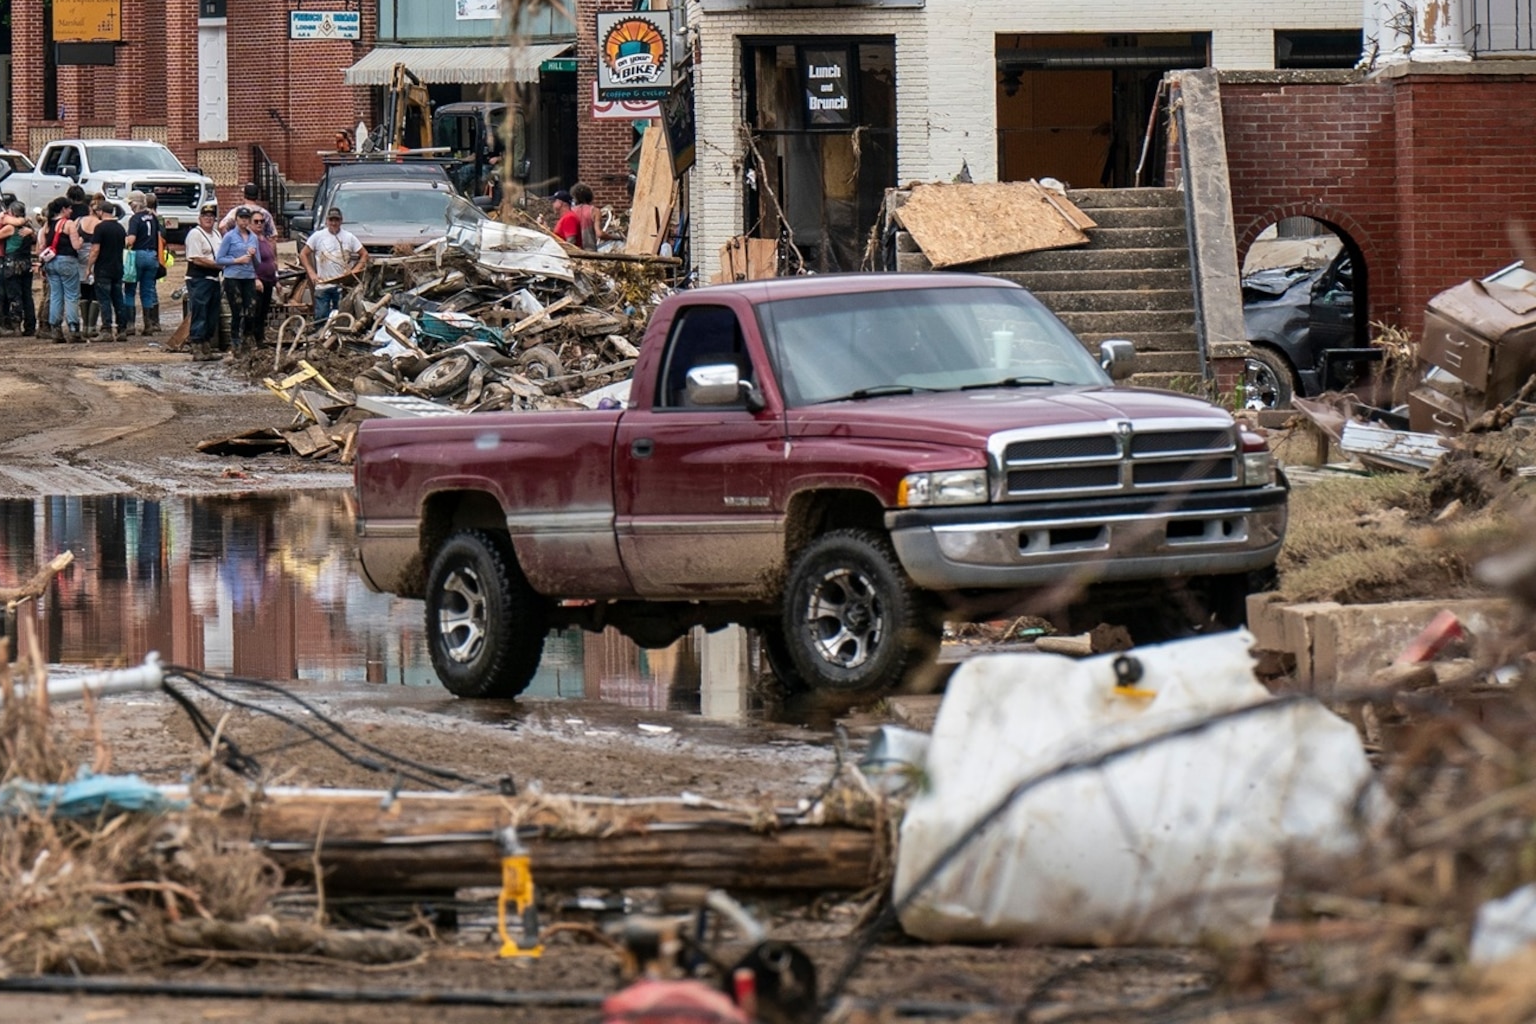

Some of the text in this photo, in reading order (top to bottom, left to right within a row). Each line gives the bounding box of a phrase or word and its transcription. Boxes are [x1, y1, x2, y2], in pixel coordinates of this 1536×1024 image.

[630, 55, 650, 63] your
[548, 61, 563, 70] HILL
[809, 64, 841, 78] Lunch
[622, 65, 654, 78] BIKE
[606, 90, 631, 98] coffee
[809, 96, 848, 110] Brunch
